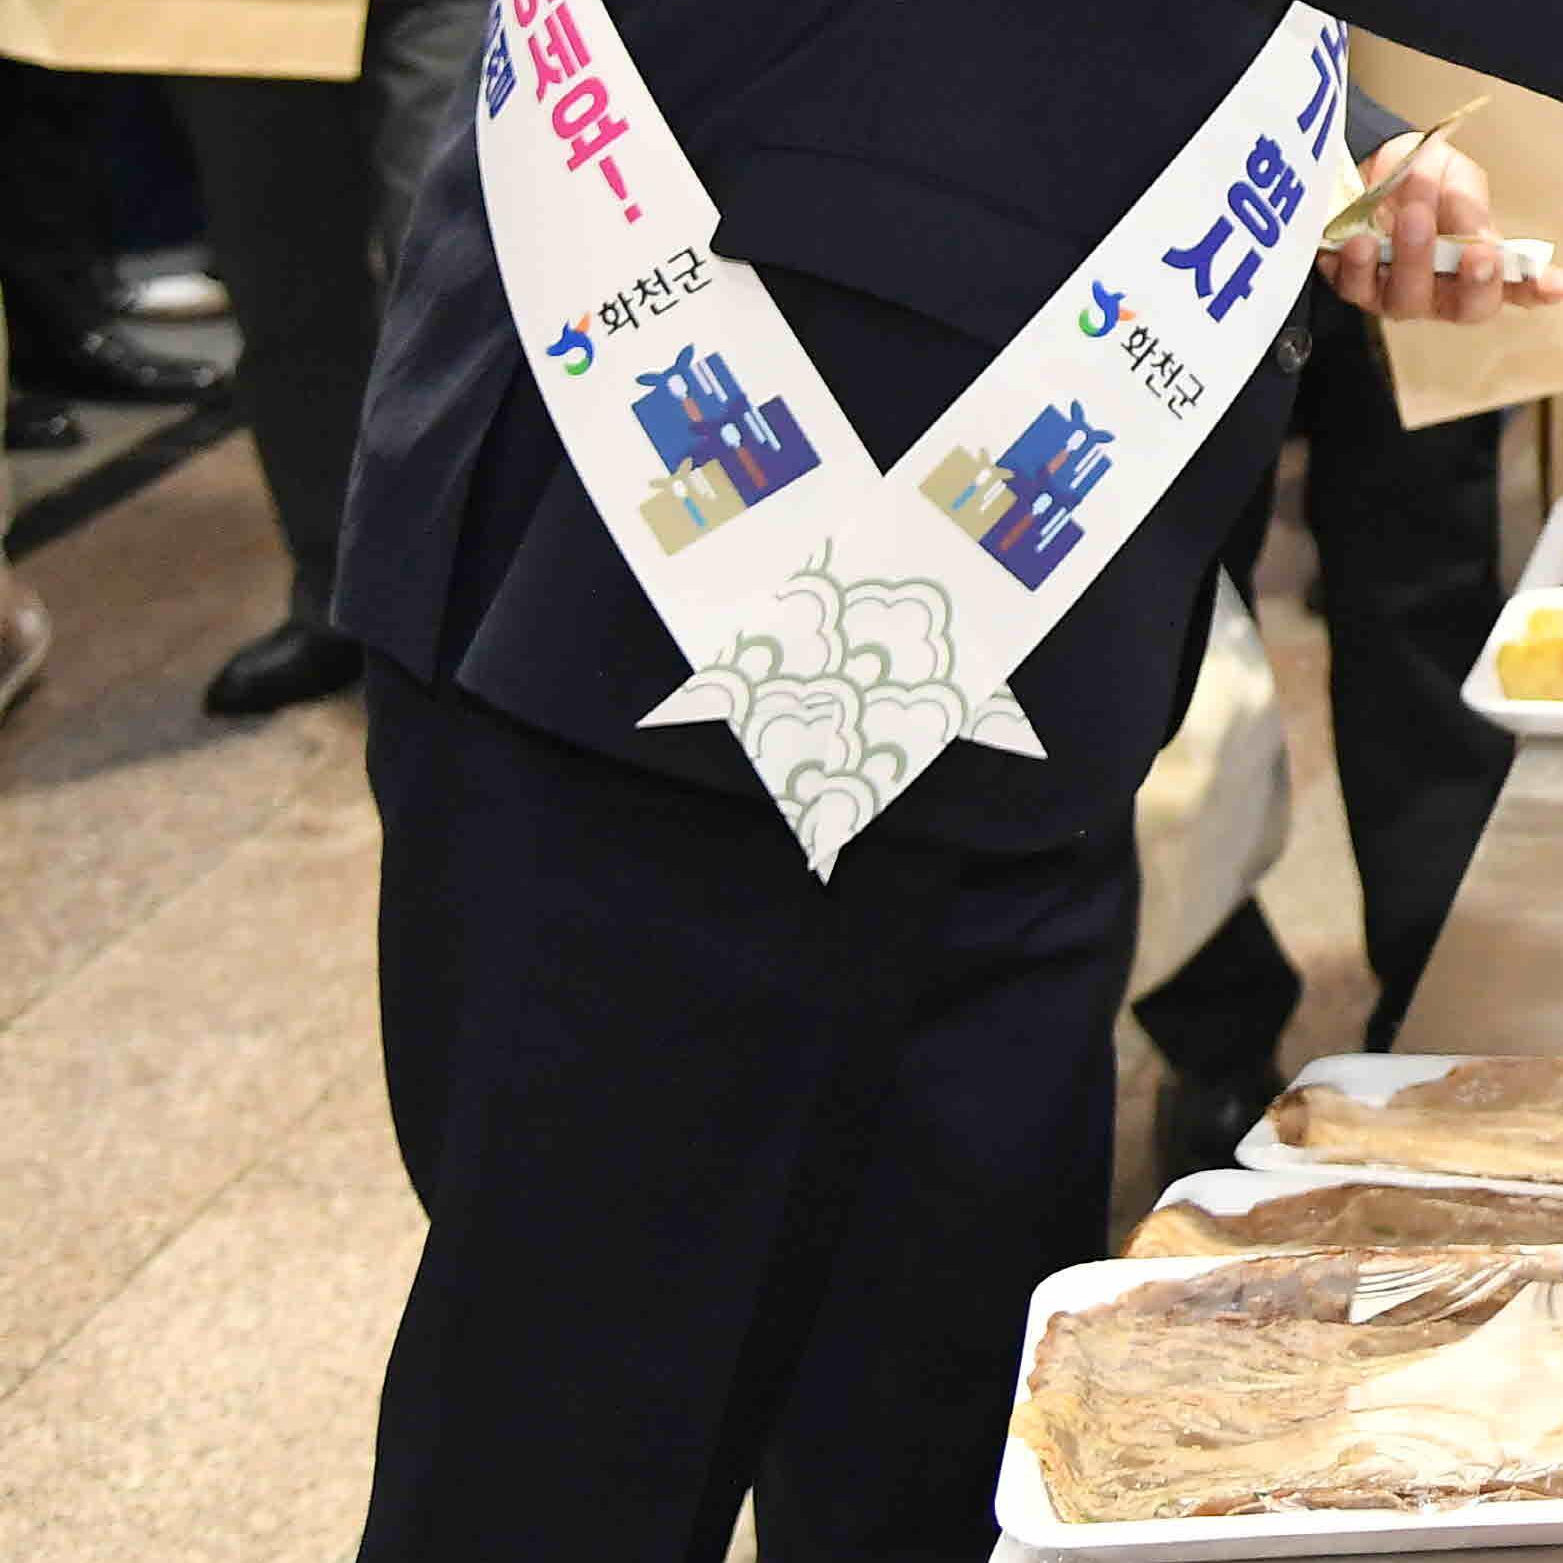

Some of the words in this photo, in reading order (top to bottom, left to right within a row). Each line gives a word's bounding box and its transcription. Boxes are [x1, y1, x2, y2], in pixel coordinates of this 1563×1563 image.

[1162, 134, 1306, 324] 행사
[597, 246, 713, 337] 화천군
[1120, 325, 1206, 421] 화천군
